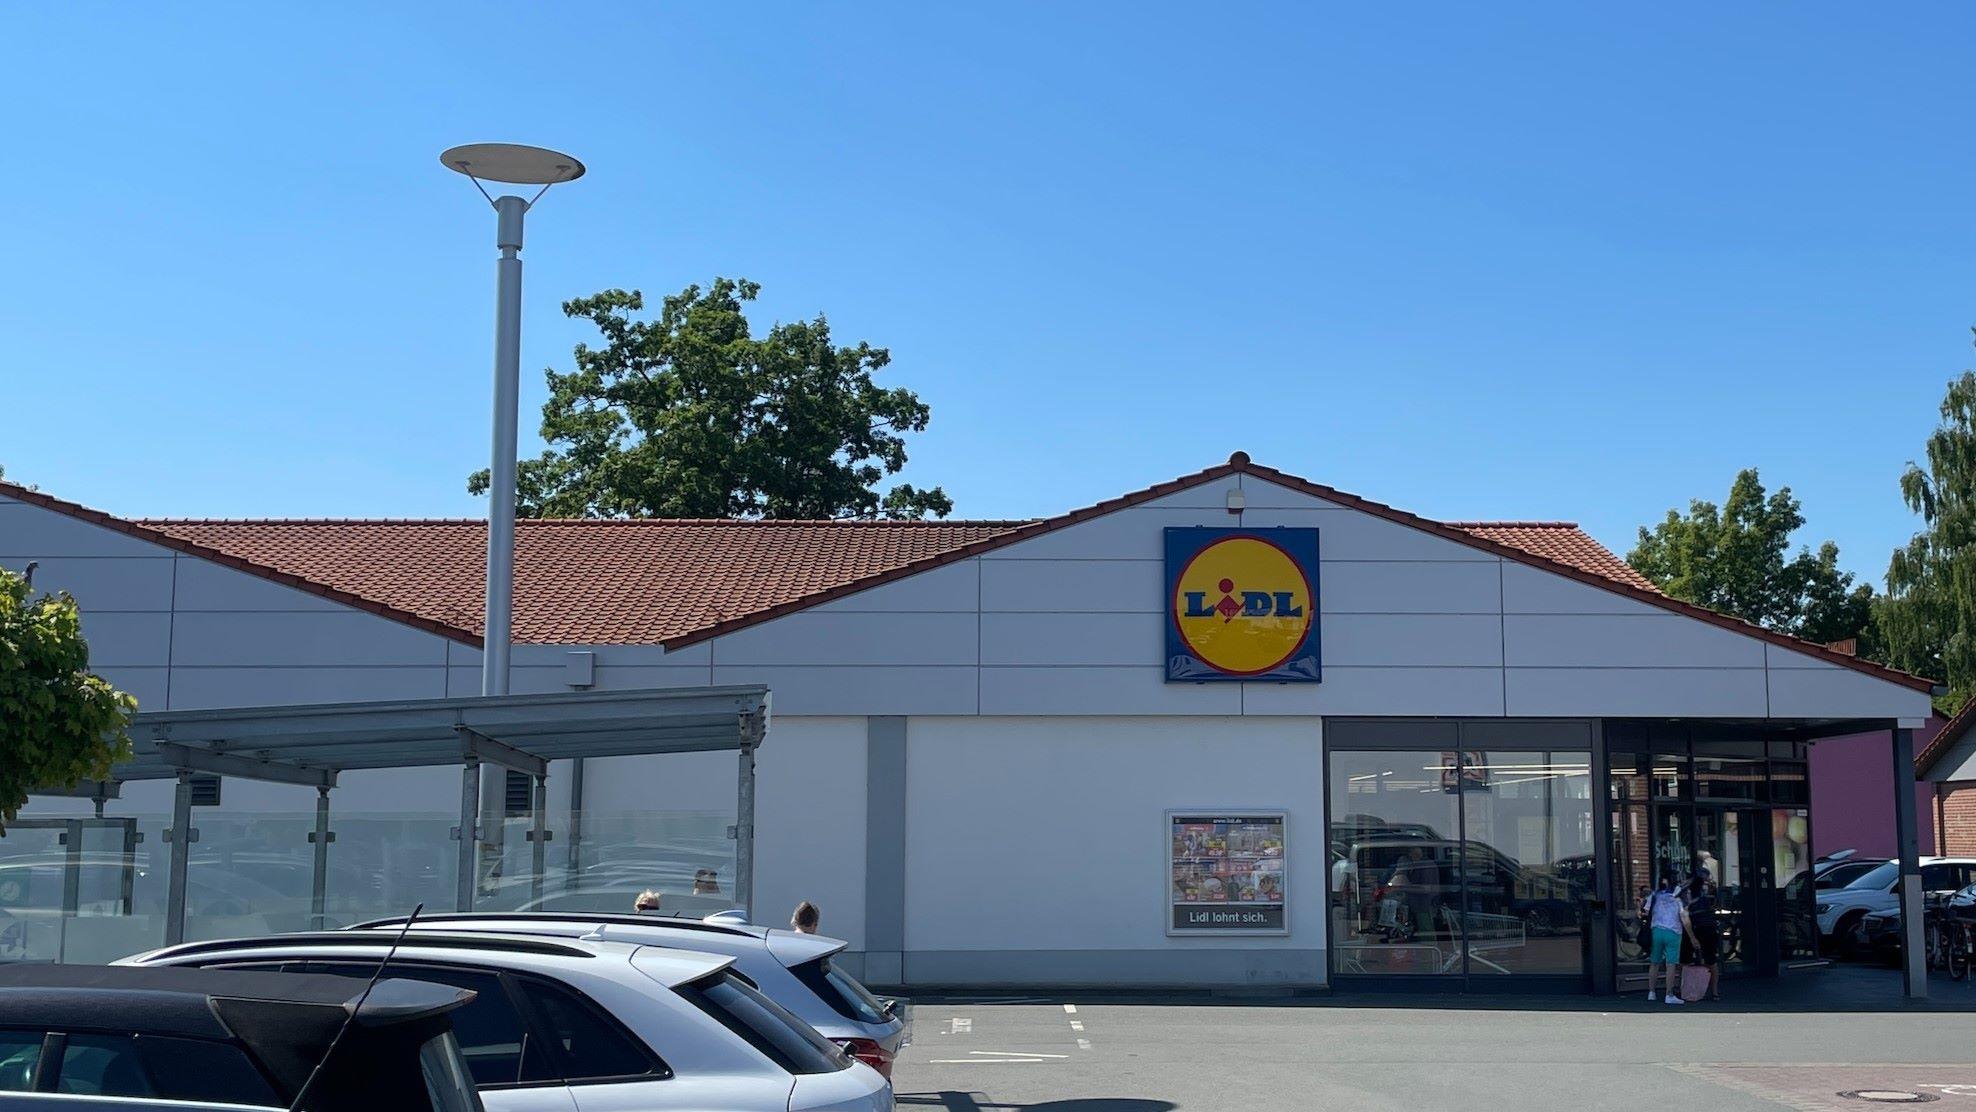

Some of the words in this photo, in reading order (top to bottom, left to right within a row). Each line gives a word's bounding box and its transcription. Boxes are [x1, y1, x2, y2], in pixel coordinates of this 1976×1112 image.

[1189, 911, 1209, 923] Lidl
[1213, 911, 1239, 923] lohnt
[1242, 911, 1268, 923] sich.
